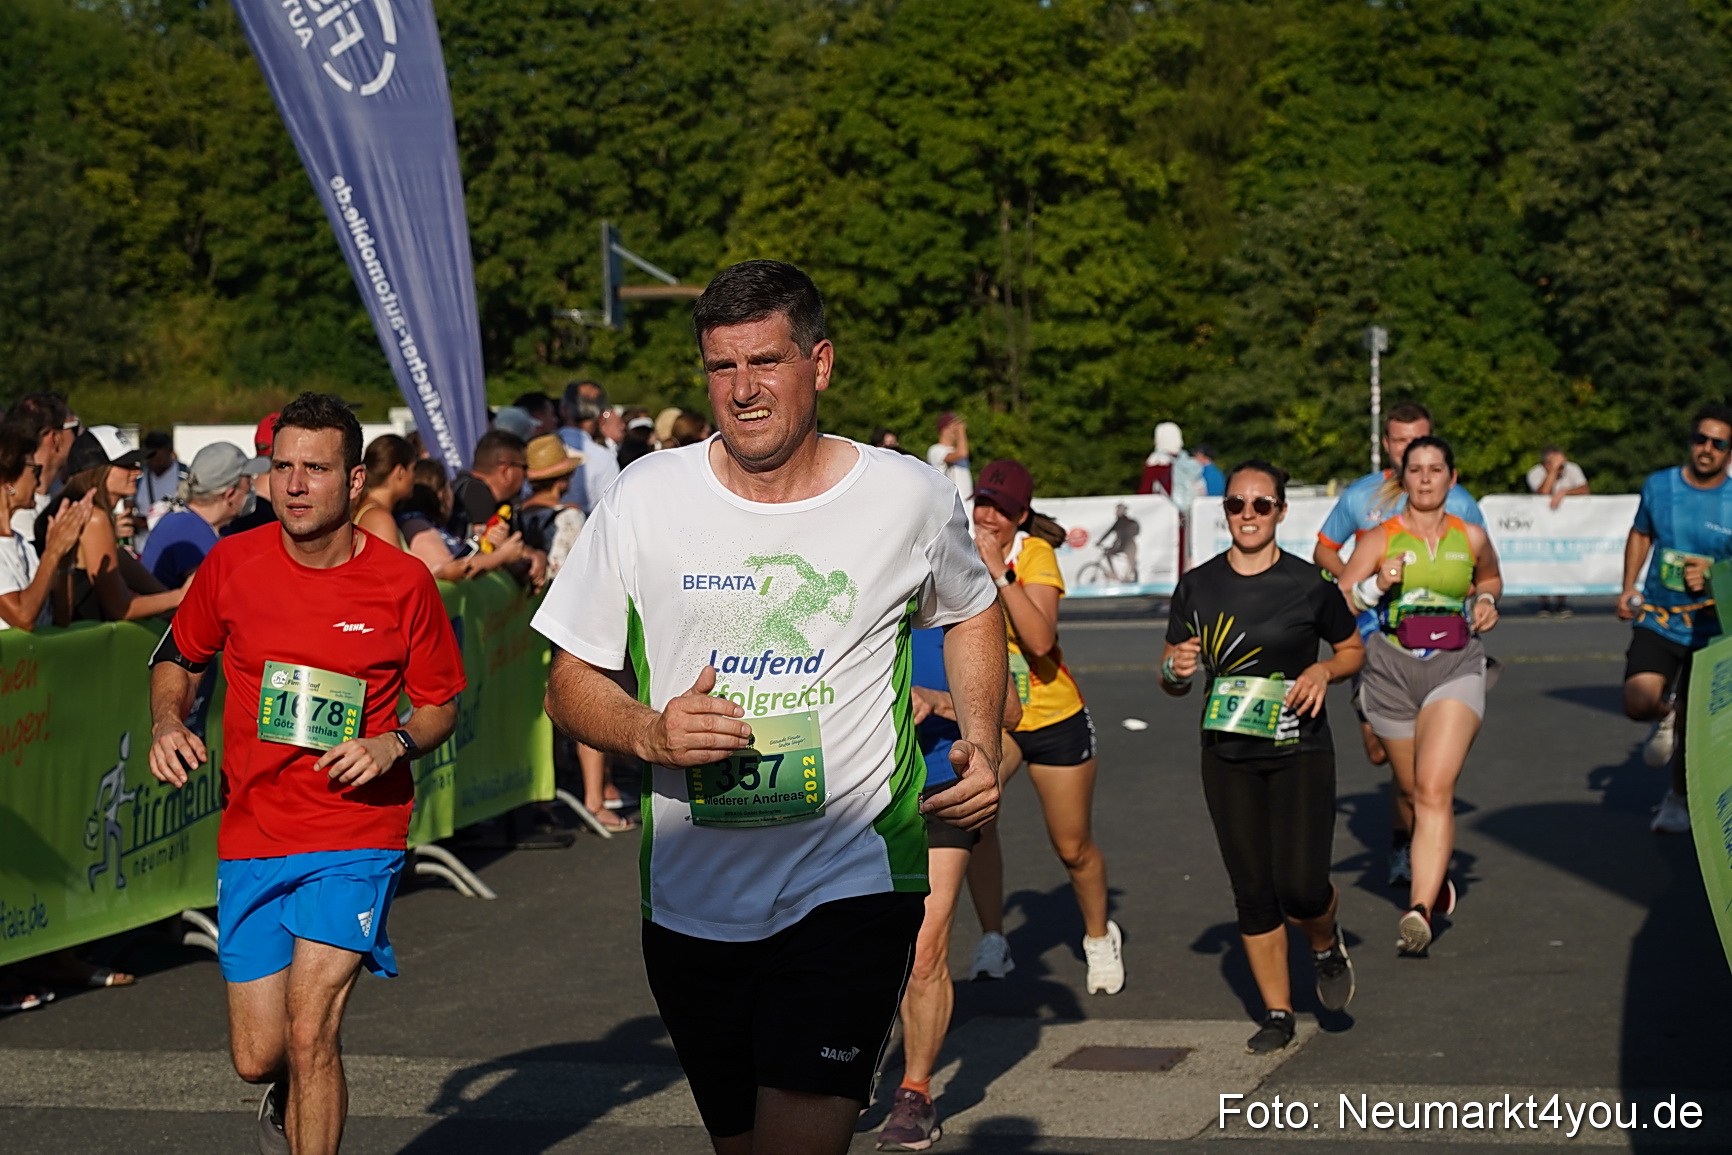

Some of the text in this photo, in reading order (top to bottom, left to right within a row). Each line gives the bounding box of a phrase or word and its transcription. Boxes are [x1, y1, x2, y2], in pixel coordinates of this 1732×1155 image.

[683, 575, 756, 590] BERATA
[710, 649, 825, 680] Laufend
[262, 697, 273, 725] RUN
[276, 691, 345, 726] 1678
[1227, 695, 1265, 717] 64
[274, 718, 295, 730] Götz
[302, 723, 338, 738] atthias
[343, 708, 357, 743] 2022
[692, 768, 705, 804] RUN
[714, 754, 784, 792] 357
[802, 755, 818, 804] 2022
[704, 791, 805, 806] Mederer Andreas
[821, 1046, 852, 1062] JAKO
